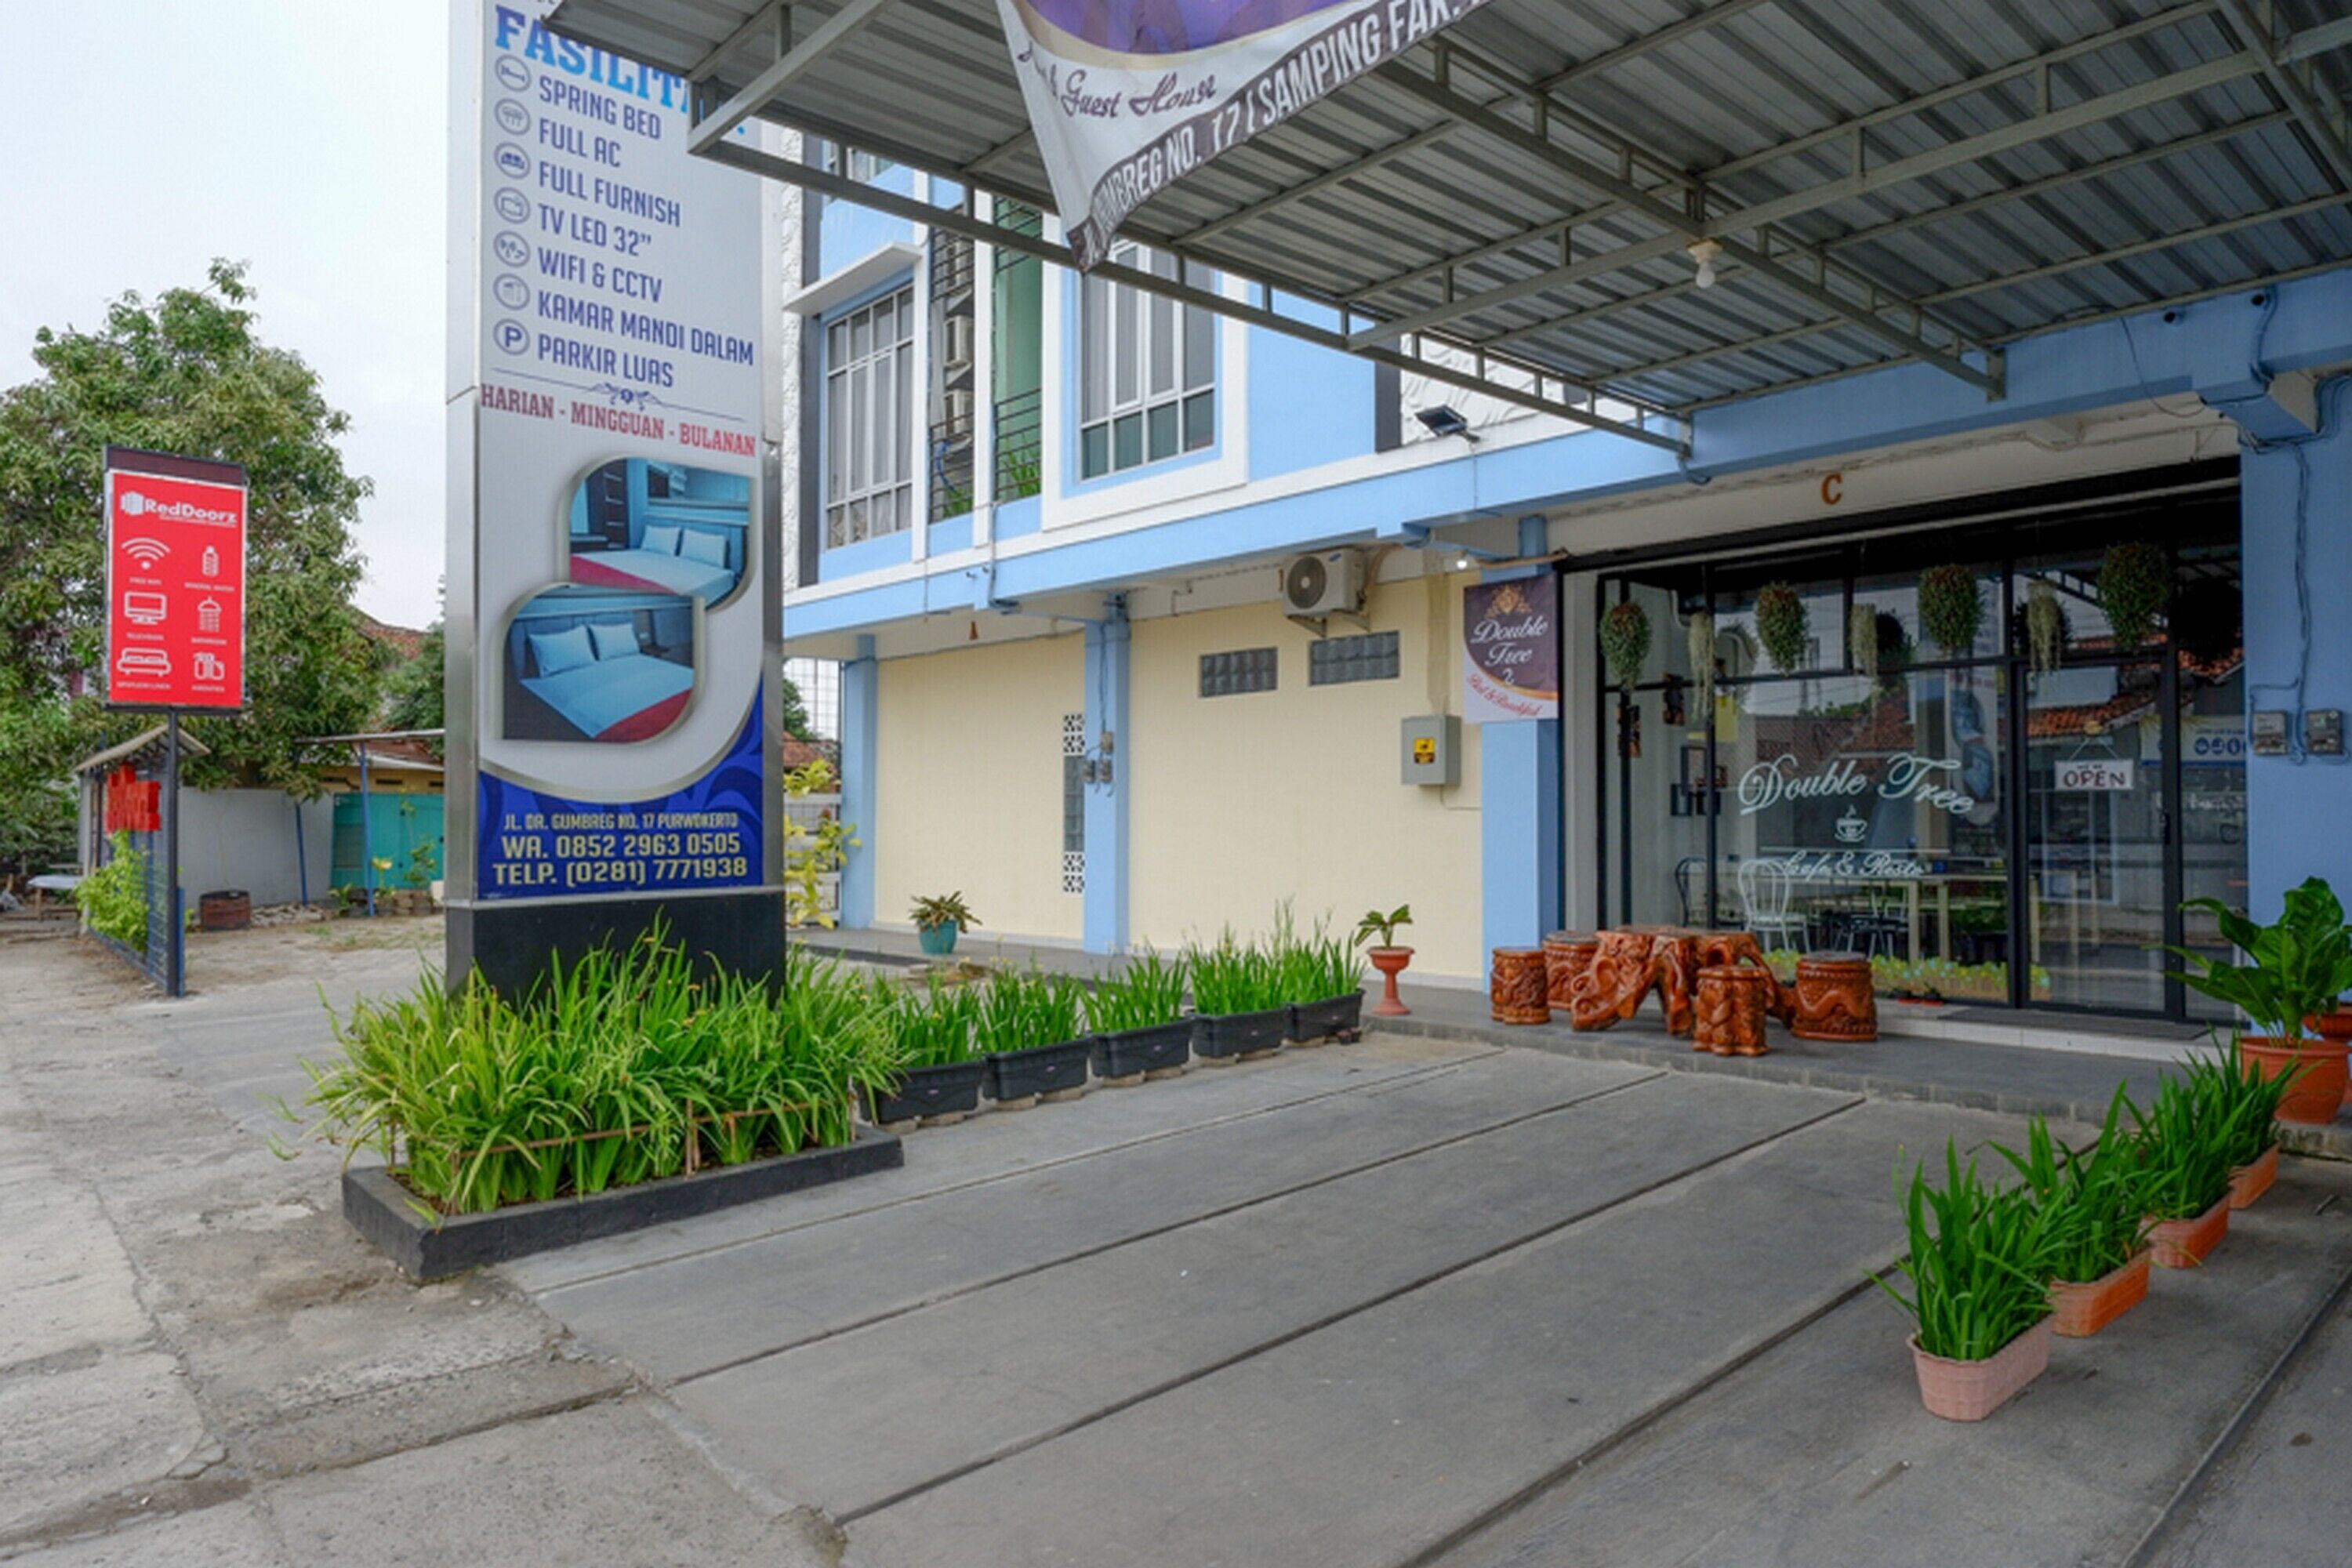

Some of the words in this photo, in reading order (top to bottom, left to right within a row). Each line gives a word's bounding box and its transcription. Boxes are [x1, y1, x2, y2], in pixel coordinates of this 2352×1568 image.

[539, 75, 617, 125] SPRING
[623, 103, 662, 140] BED
[1061, 69, 1121, 118] Guest
[1128, 71, 1216, 117] House
[540, 118, 587, 158] FULL
[594, 136, 621, 168] AC
[1166, 125, 1201, 180] NO.
[1212, 100, 1240, 152] 17
[540, 161, 587, 201] FULL
[594, 177, 681, 227] FURNISH
[538, 203, 564, 235] TV
[571, 212, 607, 248] LED
[538, 247, 585, 284] WIFI
[592, 262, 605, 289] &
[612, 267, 662, 303] CCTV
[538, 290, 614, 335] KAMAR
[621, 310, 684, 350] MANDI
[691, 328, 753, 366] DALAM
[538, 333, 616, 376] PARKIR
[623, 354, 673, 387] LUAS
[481, 383, 554, 420] HARIAN
[571, 401, 665, 441] MINGGUAN
[679, 422, 756, 458] BULANAN
[144, 497, 237, 524] RedDoorz
[1820, 473, 1842, 506] C
[1470, 615, 1548, 643] Double
[1484, 642, 1532, 667] Tree
[1503, 668, 1515, 684] 2
[1738, 753, 1867, 816] Double
[1878, 752, 1975, 815] Tree
[2063, 770, 2125, 787] OPEN
[504, 813, 522, 830] JL.
[525, 813, 548, 830] DR.
[551, 813, 615, 830] GUMBREG
[618, 812, 640, 829] NO.
[642, 812, 655, 829] 17
[657, 812, 738, 829] PURWOKERTO
[502, 835, 548, 859] WA.
[556, 835, 615, 858] 0852
[623, 833, 680, 857] 2963
[687, 832, 740, 855] 0505
[1835, 850, 1855, 877] &
[492, 862, 557, 886] TELP.
[566, 859, 645, 887] (0281)
[653, 857, 747, 880] 7771938
